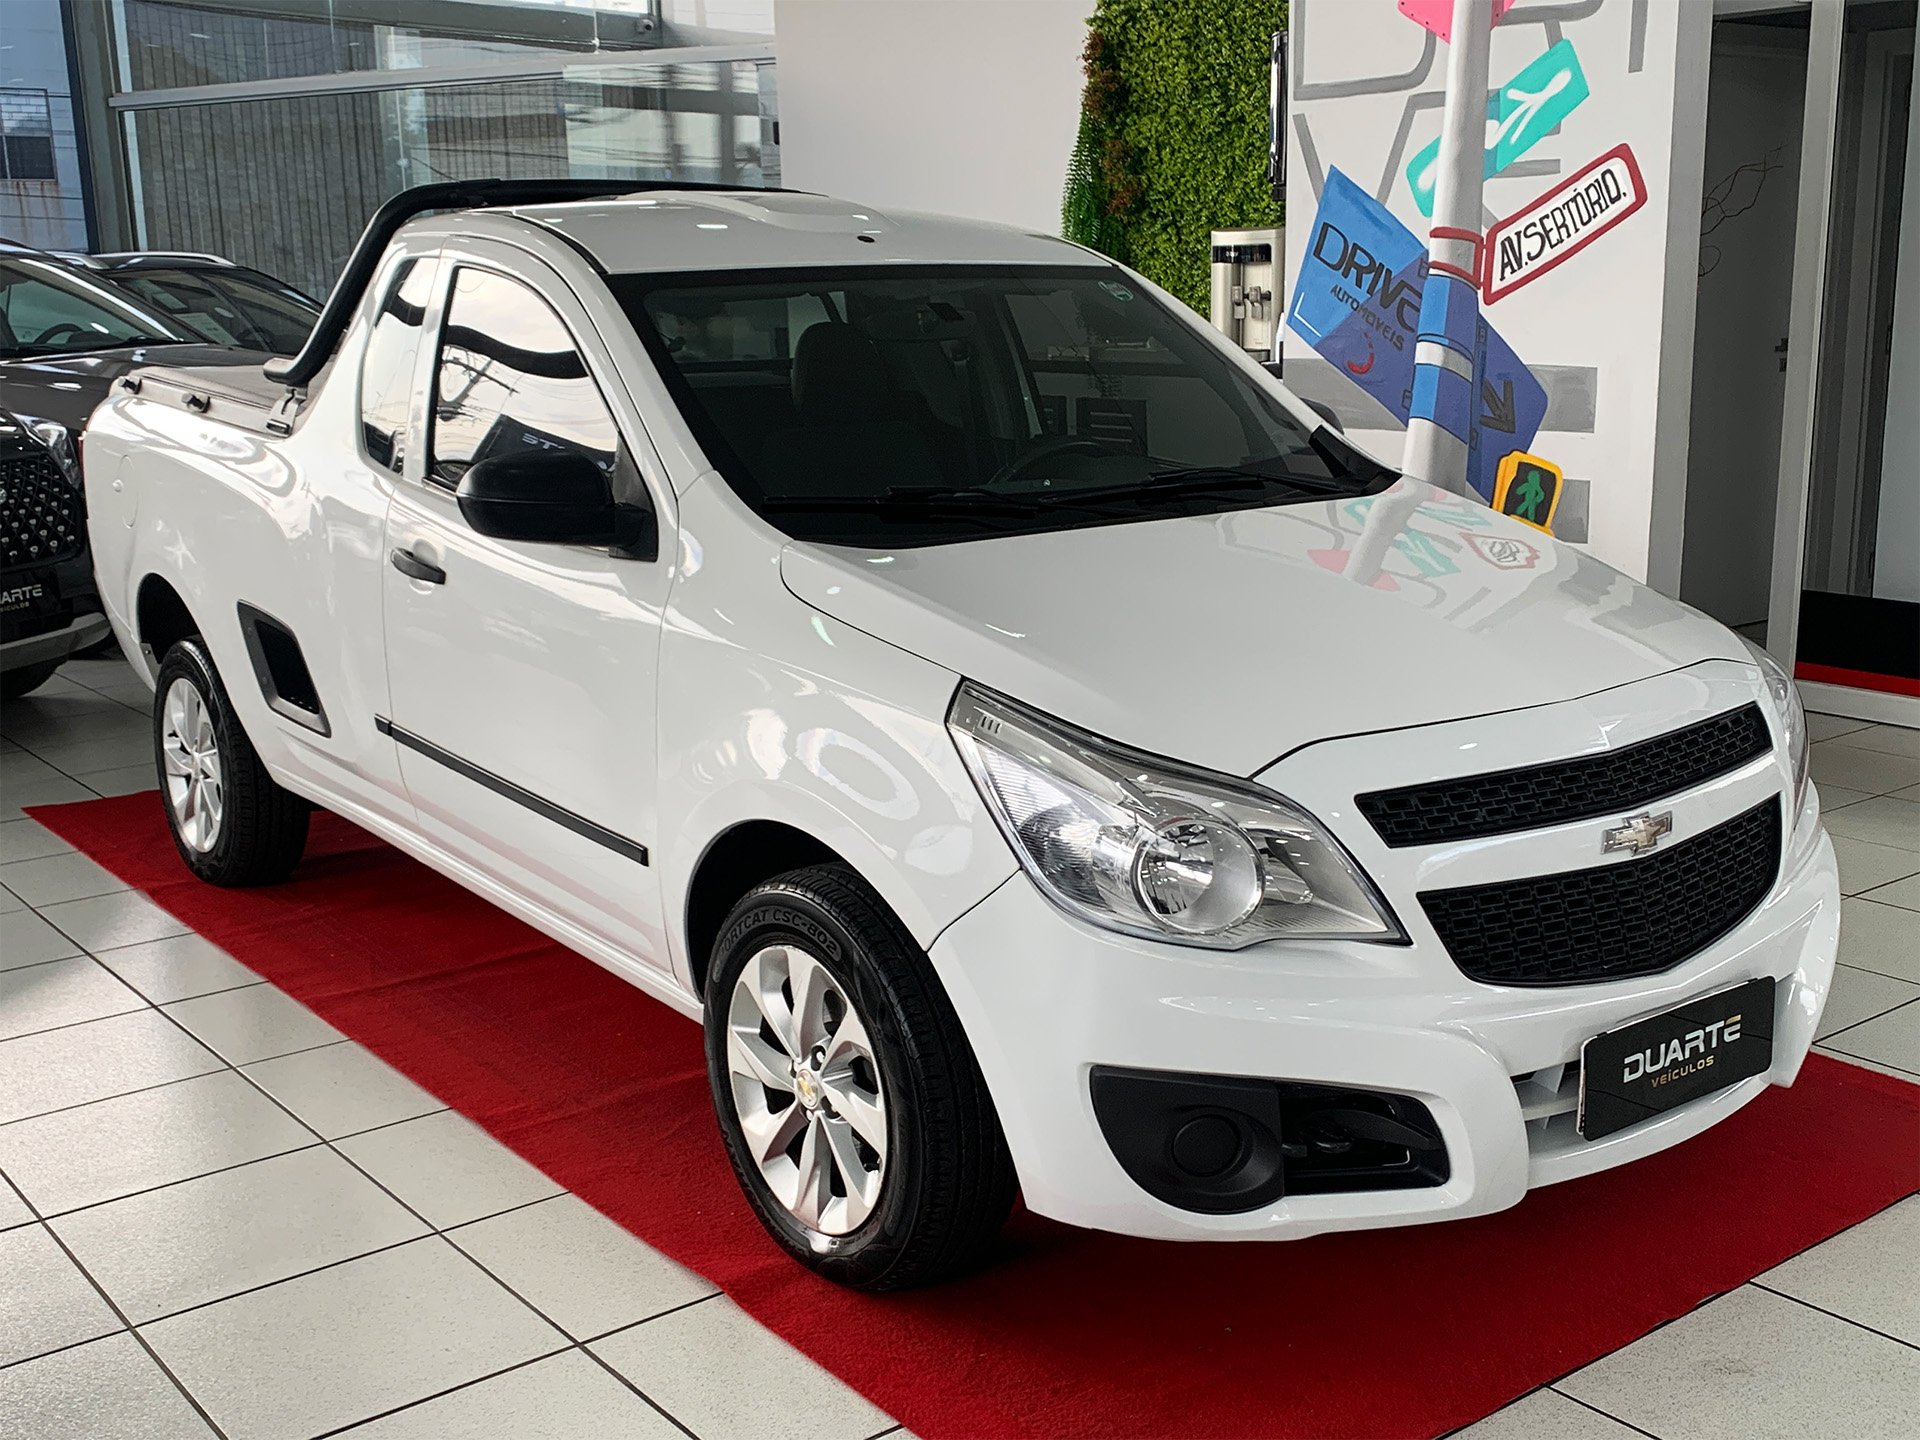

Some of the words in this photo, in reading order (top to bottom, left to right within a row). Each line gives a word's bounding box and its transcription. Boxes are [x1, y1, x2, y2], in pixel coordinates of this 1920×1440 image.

[0, 584, 43, 604] ARTE
[772, 909, 838, 955] CSC-802
[1623, 1014, 1741, 1083] DUARTE
